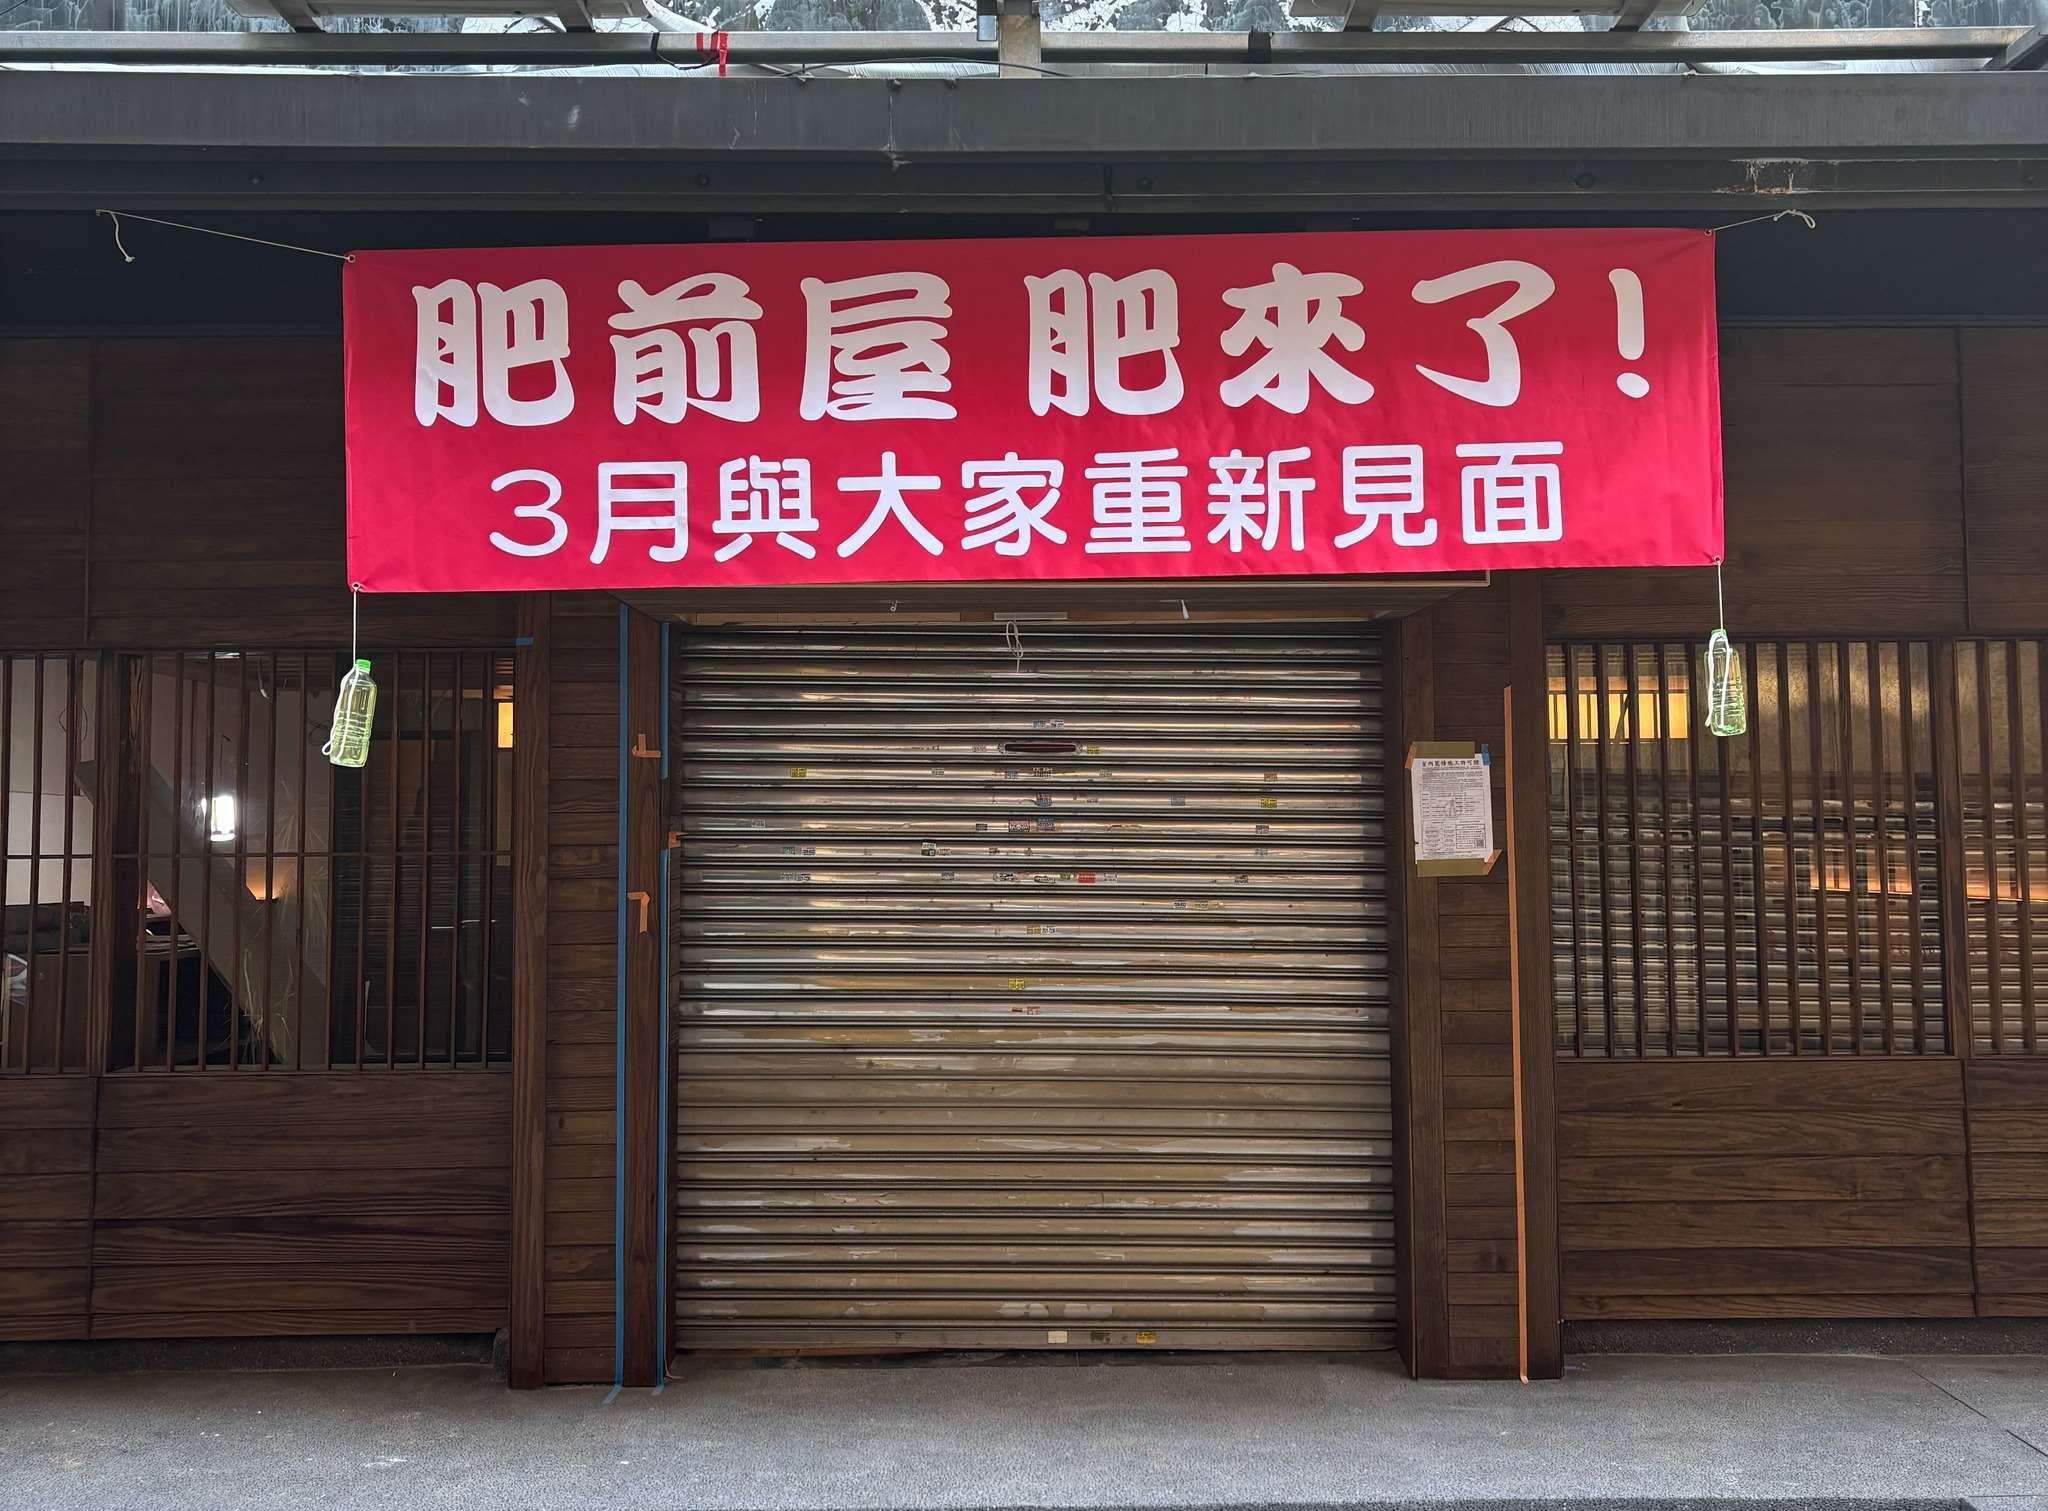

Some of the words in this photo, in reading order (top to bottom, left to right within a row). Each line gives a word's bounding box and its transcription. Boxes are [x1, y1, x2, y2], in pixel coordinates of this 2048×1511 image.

[411, 271, 958, 427] 肥前屋
[489, 441, 1564, 565] 3月與大家重新見面
